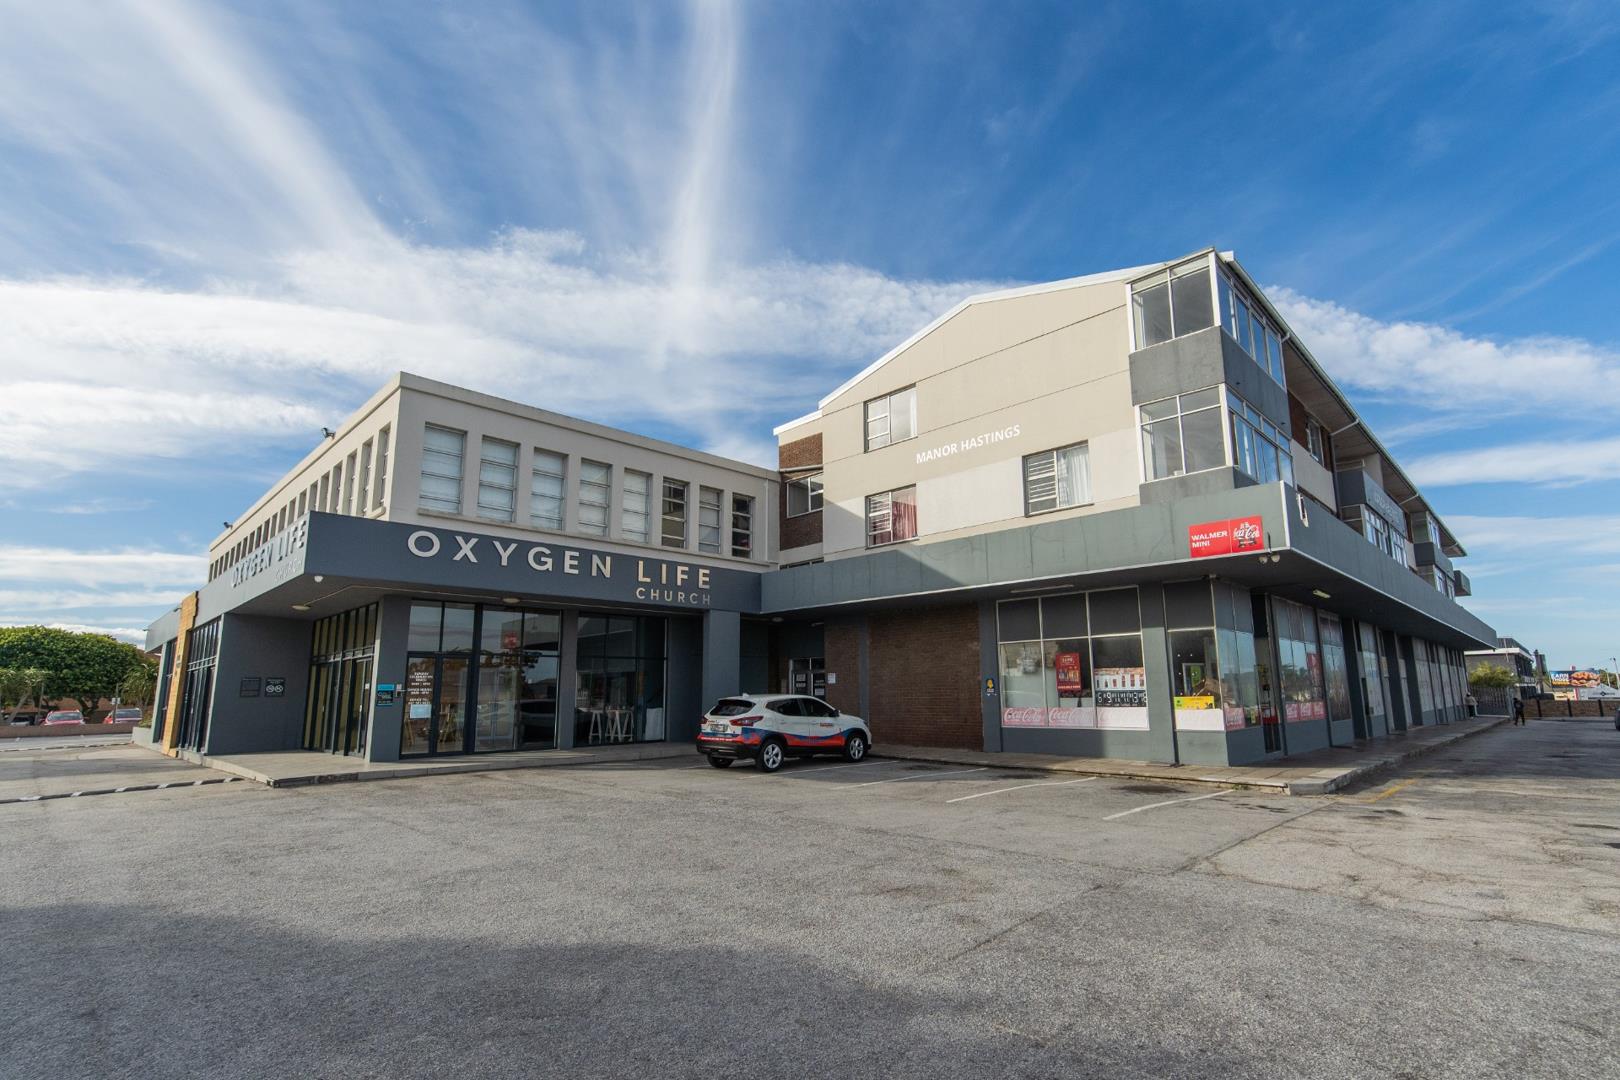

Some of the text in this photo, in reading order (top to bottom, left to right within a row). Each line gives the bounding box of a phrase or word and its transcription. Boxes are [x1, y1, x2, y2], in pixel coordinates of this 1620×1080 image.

[916, 424, 1021, 464] MANOR HASTINGS
[1191, 531, 1228, 541] WALMER
[1192, 540, 1210, 548] MINI
[231, 520, 307, 588] OXYGEN LIFE
[407, 530, 711, 589] OXYGEN LIFE
[636, 587, 711, 605] CHURCH
